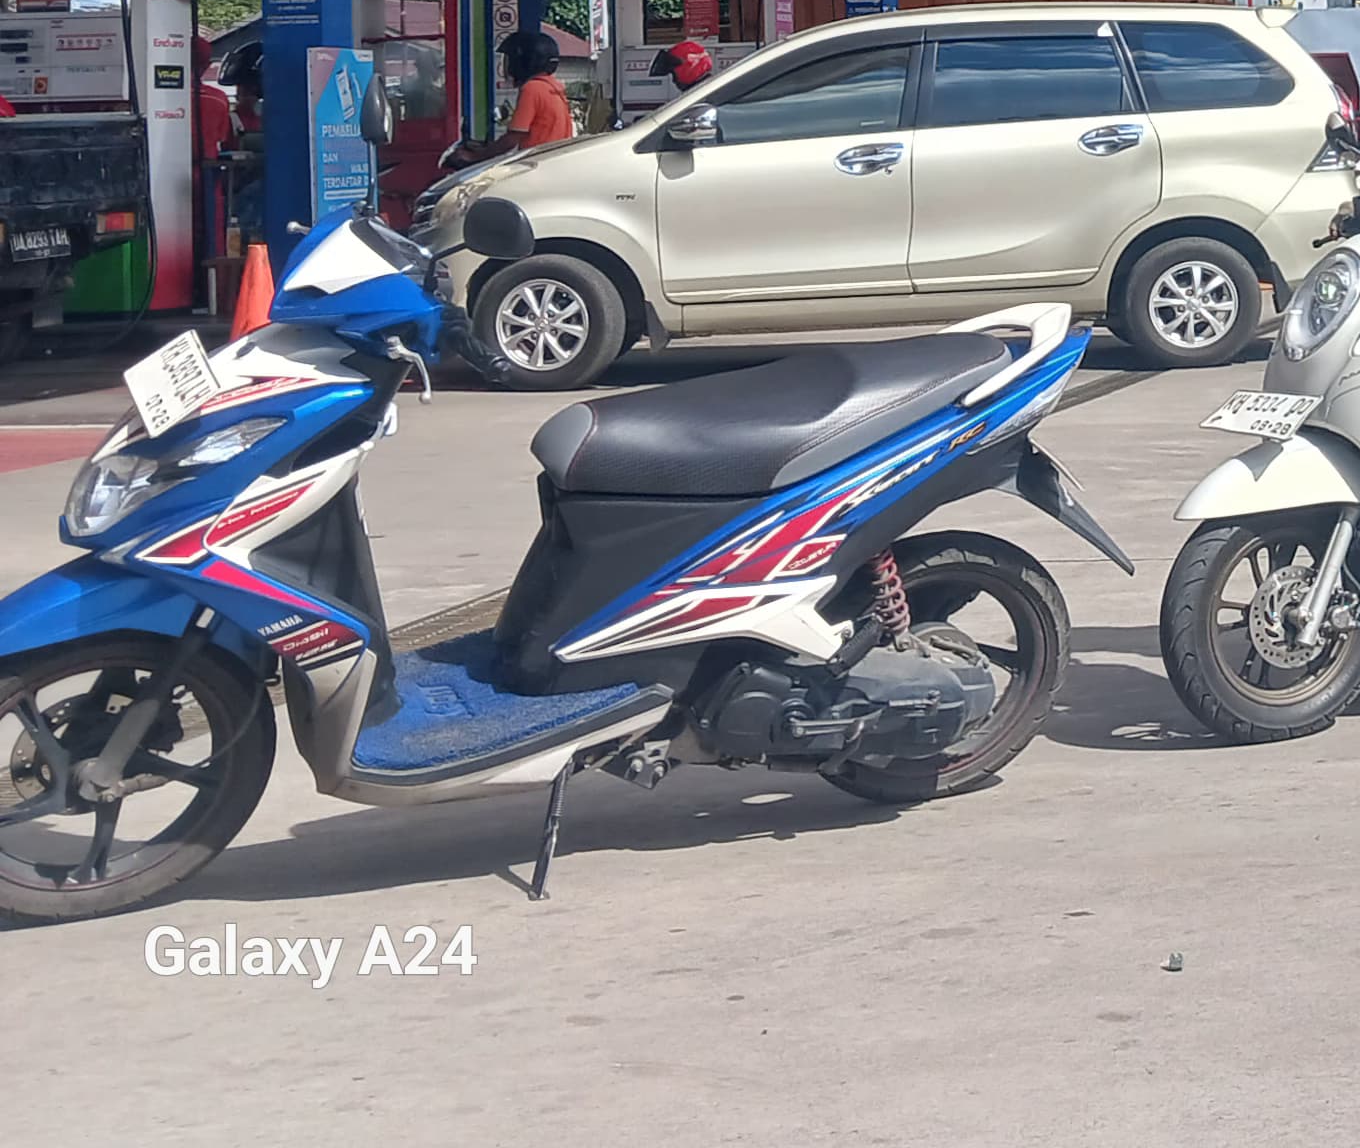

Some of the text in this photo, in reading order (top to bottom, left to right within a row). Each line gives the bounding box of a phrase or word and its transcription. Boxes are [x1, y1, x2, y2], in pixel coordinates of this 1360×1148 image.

[321, 124, 362, 137] PEMBELIA
[1222, 394, 1252, 414] KH
[257, 614, 304, 637] YAMAHA
